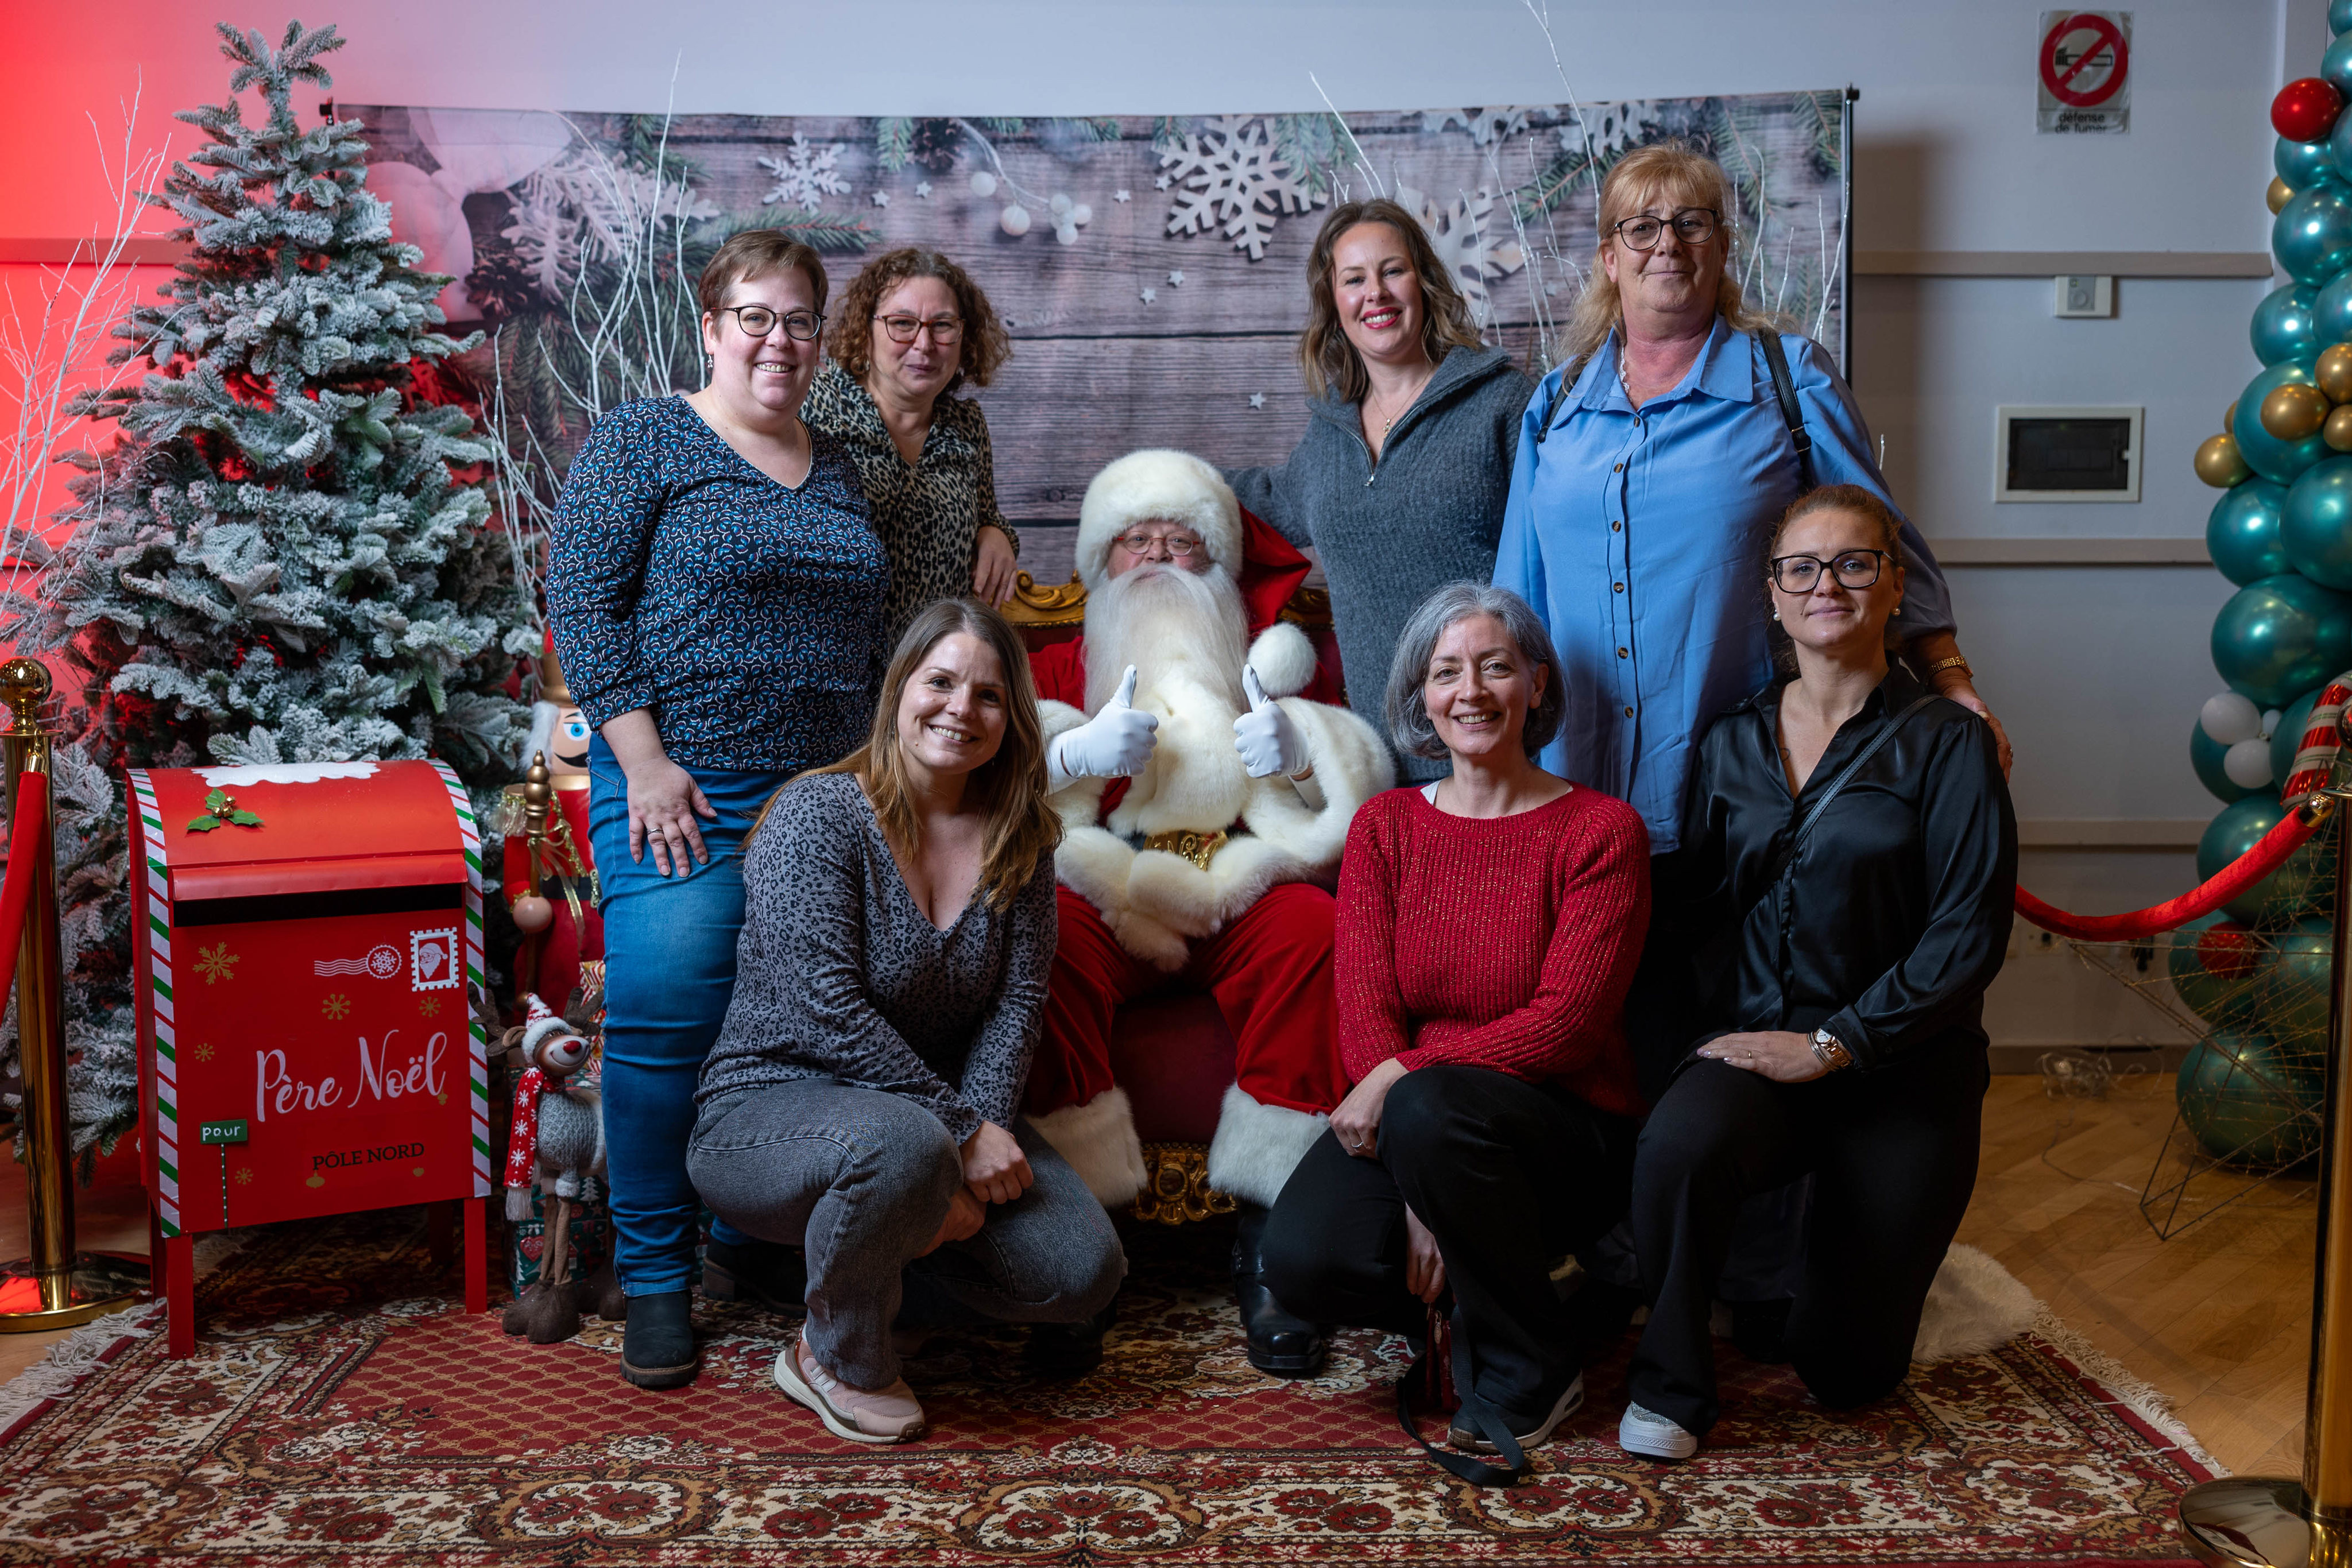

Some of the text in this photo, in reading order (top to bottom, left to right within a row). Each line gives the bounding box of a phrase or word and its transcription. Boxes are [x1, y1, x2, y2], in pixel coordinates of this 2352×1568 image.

[2055, 123, 2107, 134] de fumer
[256, 1029, 447, 1122] Père Noël
[202, 1125, 241, 1141] pour
[312, 1142, 425, 1171] PÔLE NORD
